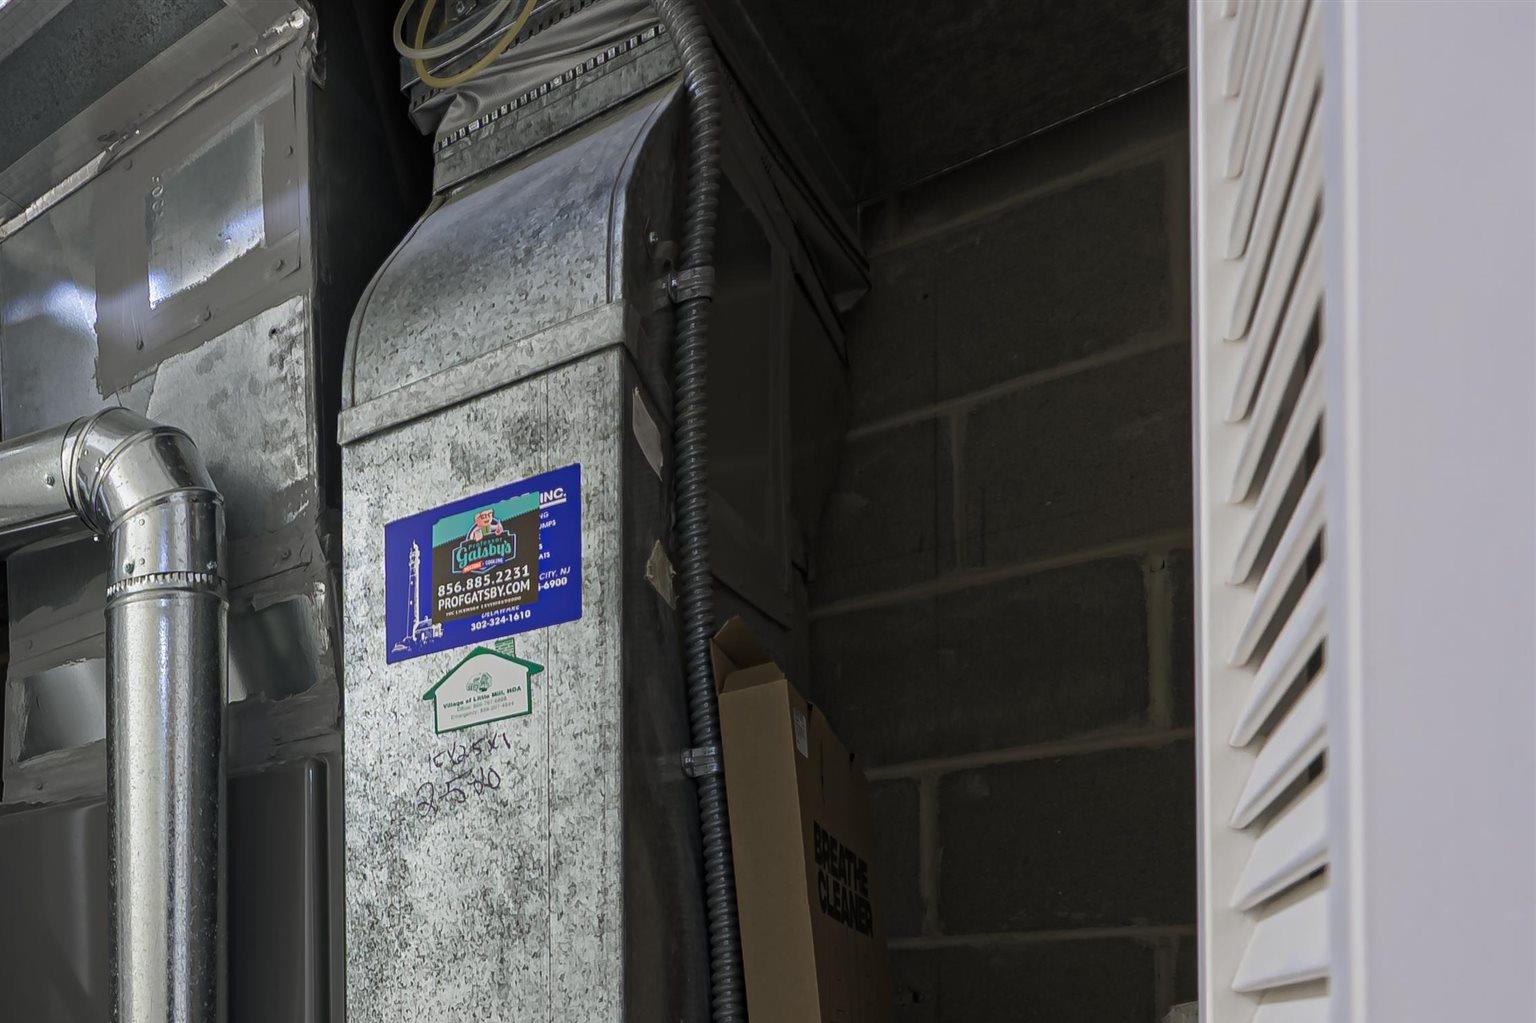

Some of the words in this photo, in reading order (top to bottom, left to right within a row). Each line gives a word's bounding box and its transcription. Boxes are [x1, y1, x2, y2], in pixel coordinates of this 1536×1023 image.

[540, 488, 567, 504] INC.
[456, 540, 512, 568] Gatsby's
[437, 564, 531, 597] 856.885.2231
[560, 566, 571, 576] NJ
[437, 578, 531, 611] PROFGATSBY.COM
[470, 609, 531, 632] 302-324-1610
[443, 700, 464, 710] Village
[473, 693, 490, 703] Little
[506, 685, 522, 694] HOA
[813, 819, 869, 899] BREATHE
[817, 867, 874, 940] CLEANER
